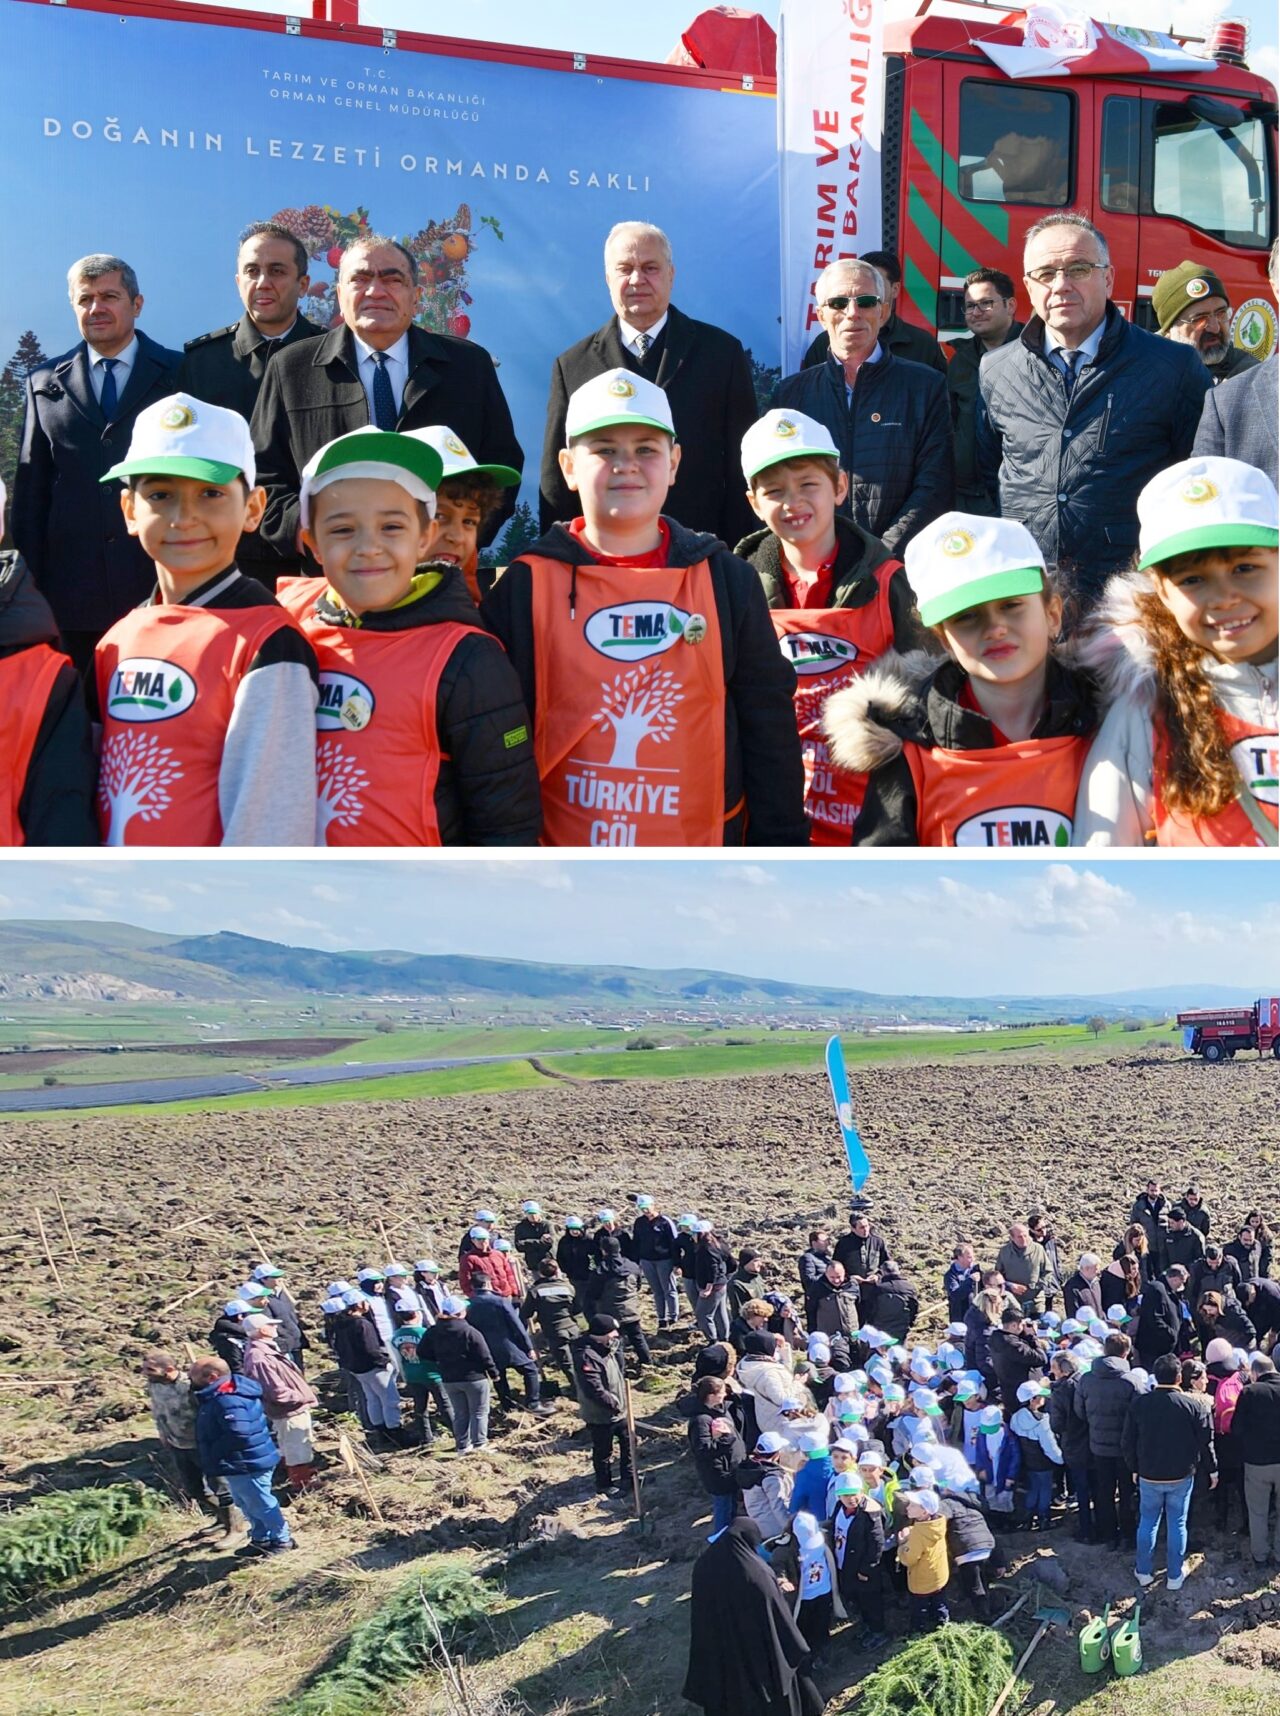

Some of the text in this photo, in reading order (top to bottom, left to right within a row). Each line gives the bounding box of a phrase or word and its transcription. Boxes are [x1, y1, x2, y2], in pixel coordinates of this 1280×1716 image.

[263, 70, 486, 106] TARIM VE ORMAN BAKANLIĞI
[364, 67, 391, 80] T.C.
[270, 88, 480, 122] ORMAN GENEL MÜDÜRLÜĞÜ
[812, 109, 839, 167] VE
[43, 116, 650, 192] DOĞANIN LEZZETİ ORMANDA SAKLI
[609, 613, 666, 638] TEMA
[788, 640, 837, 659] TEMA
[115, 671, 164, 698] TEMA
[318, 683, 343, 708] MA
[565, 770, 680, 816] TÜRKİYE
[812, 765, 838, 796] ÖL
[981, 820, 1051, 847] TEMA
